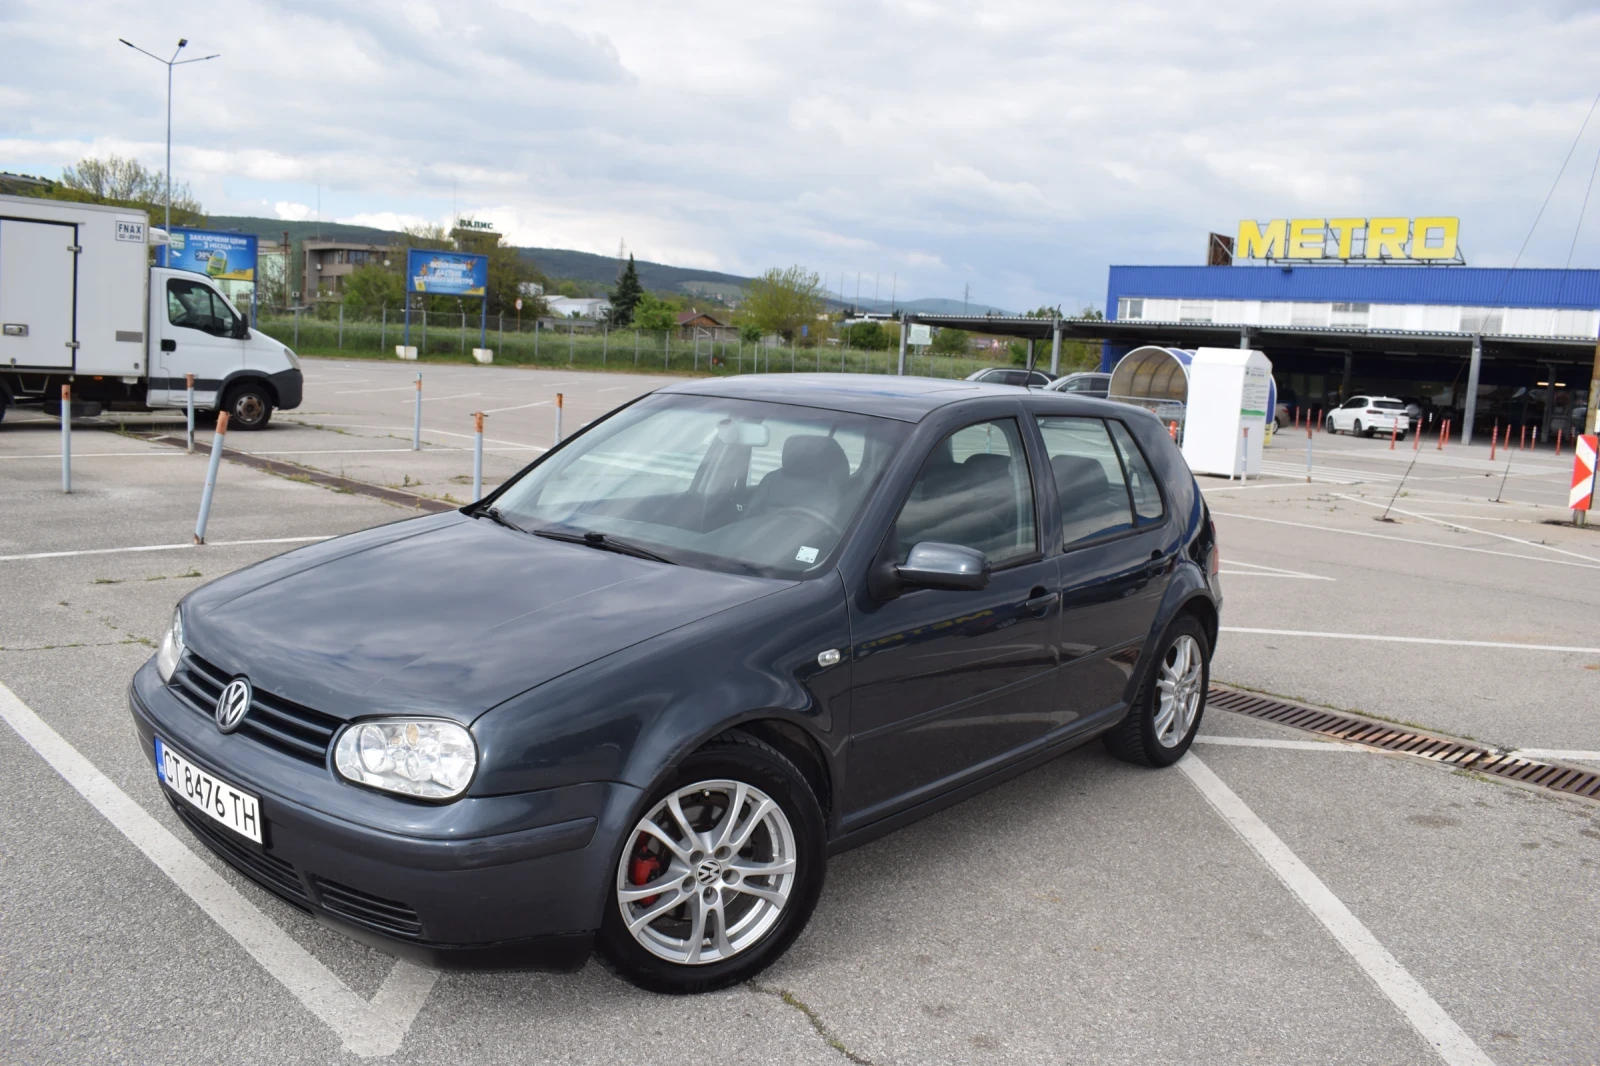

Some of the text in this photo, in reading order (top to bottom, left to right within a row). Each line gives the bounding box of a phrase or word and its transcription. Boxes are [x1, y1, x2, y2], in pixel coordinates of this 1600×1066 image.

[118, 223, 142, 234] FNAX
[1236, 216, 1460, 260] METRO
[164, 750, 180, 788] CT
[184, 765, 226, 818] 8476
[229, 790, 257, 837] TH
